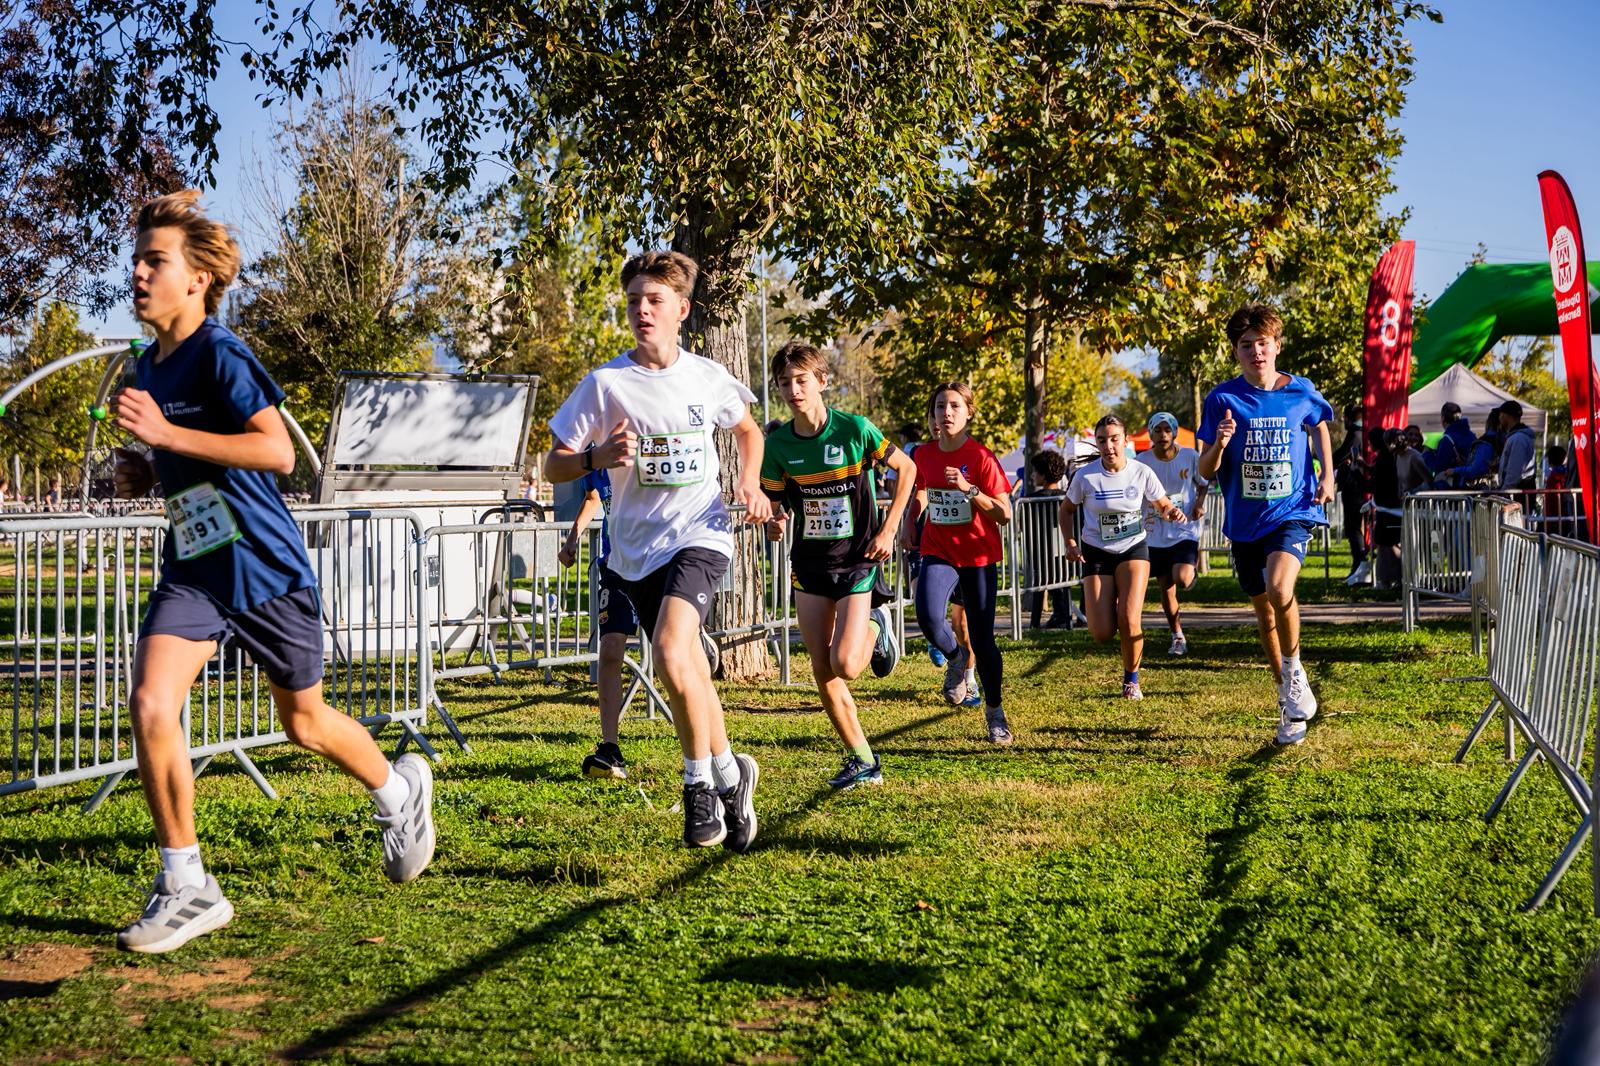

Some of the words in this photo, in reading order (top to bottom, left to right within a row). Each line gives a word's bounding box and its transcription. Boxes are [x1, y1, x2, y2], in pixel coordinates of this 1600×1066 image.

[1250, 416, 1287, 429] INSTITUT
[1245, 429, 1291, 446] ARNAU
[642, 445, 668, 453] CROS
[1244, 446, 1291, 461] CADELL
[646, 460, 698, 475] 3094
[1249, 482, 1283, 491] 3641
[935, 508, 959, 517] 799
[810, 519, 843, 530] 2764
